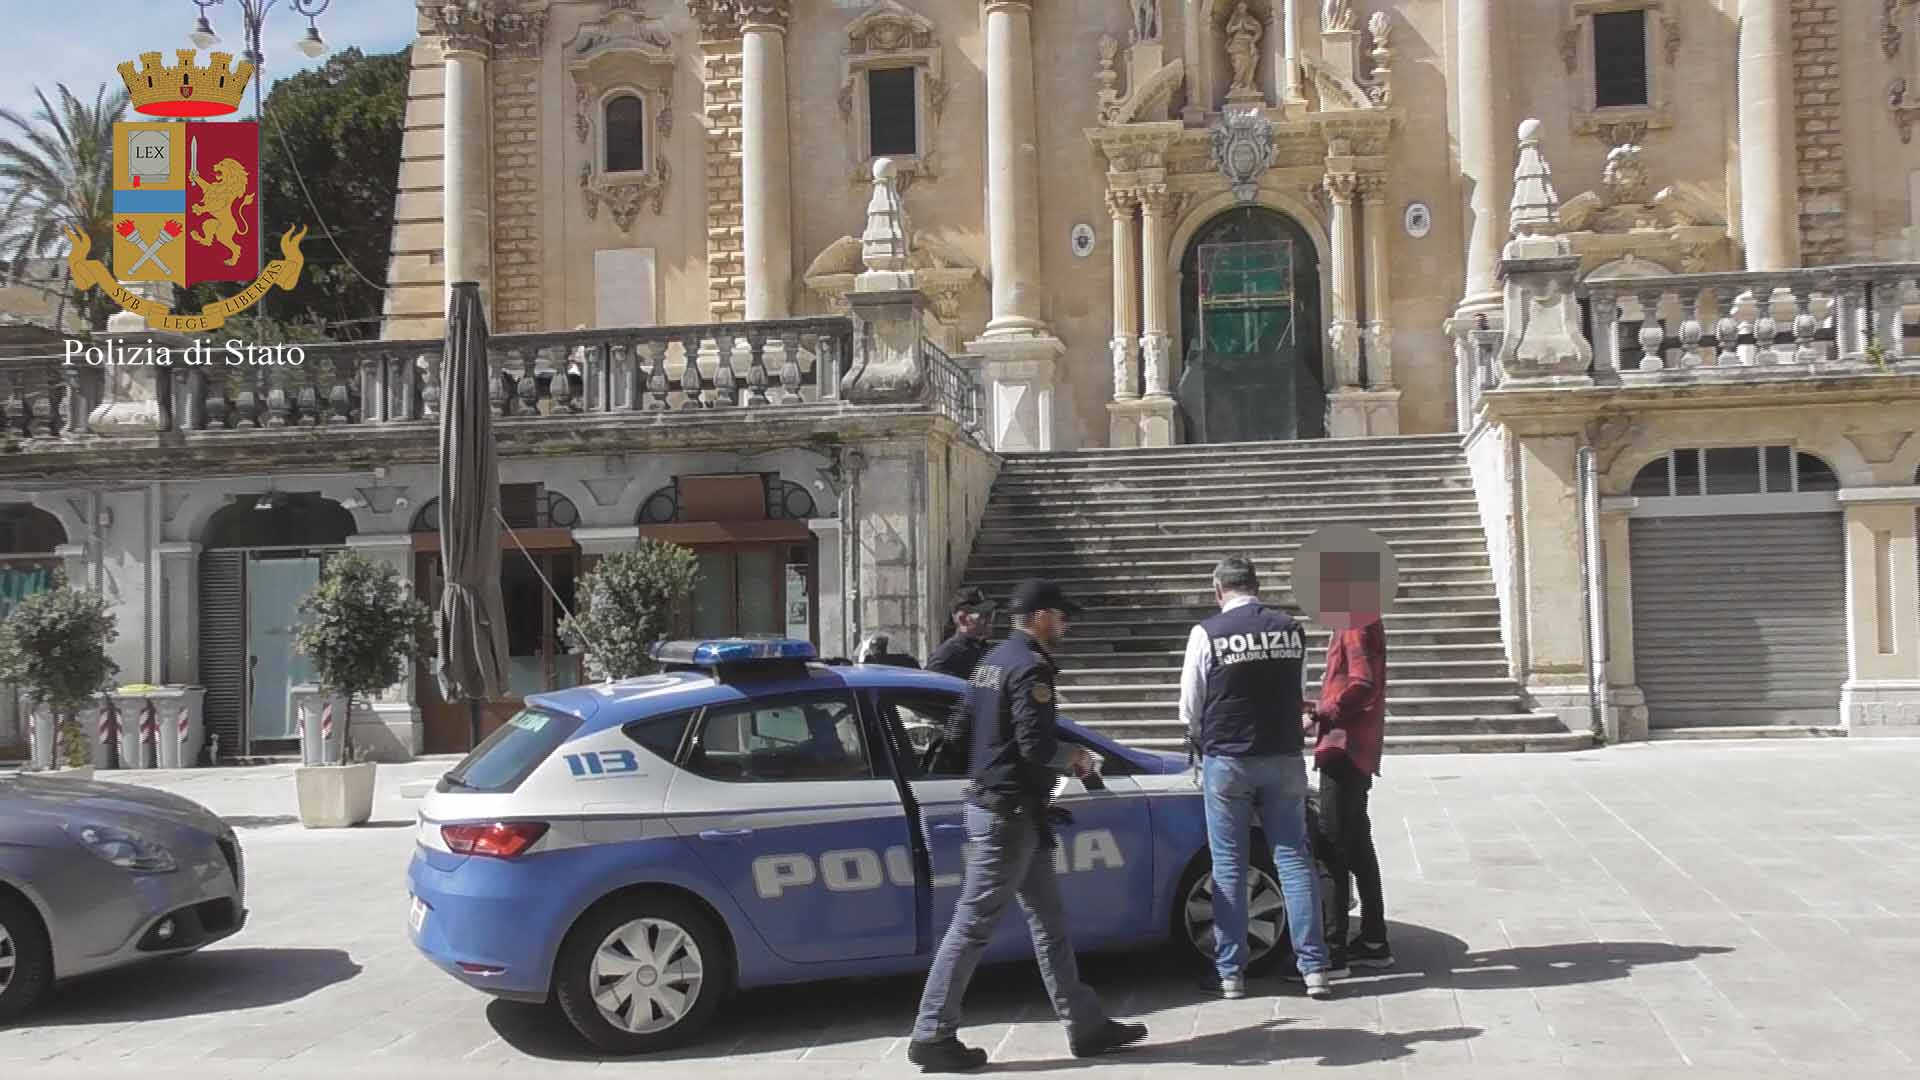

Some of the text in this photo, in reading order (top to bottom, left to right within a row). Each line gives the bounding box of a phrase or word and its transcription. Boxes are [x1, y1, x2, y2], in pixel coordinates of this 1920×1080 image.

[1213, 630, 1303, 657] POLIZIA
[562, 750, 639, 776] 113
[751, 829, 1126, 899] POLIA
